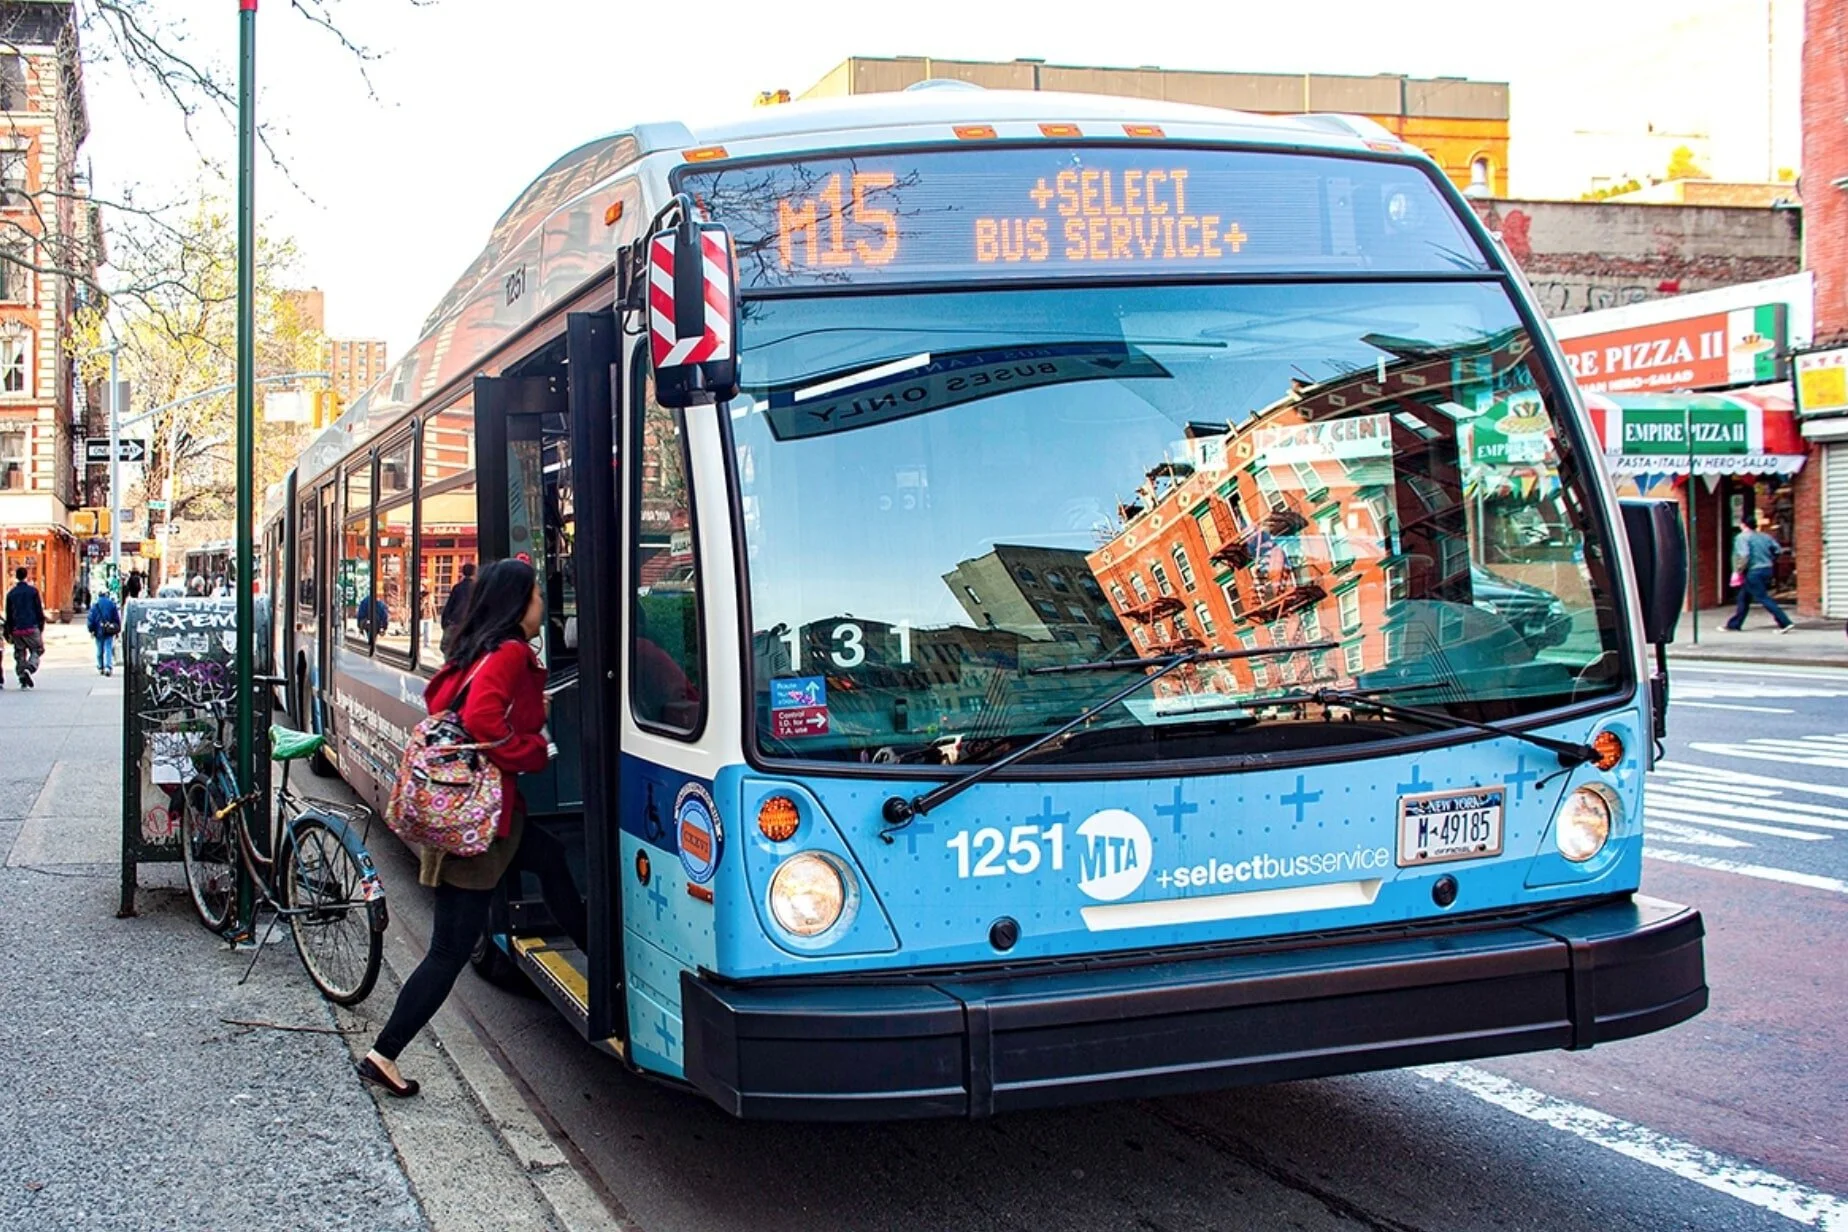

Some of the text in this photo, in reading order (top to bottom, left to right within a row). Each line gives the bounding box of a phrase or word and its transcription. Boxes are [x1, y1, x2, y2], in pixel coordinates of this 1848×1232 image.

[778, 172, 897, 267] M15
[976, 218, 1049, 261] BUS
[505, 264, 526, 306] 1251
[1604, 337, 1694, 374] PIZZA
[1699, 331, 1724, 360] II
[1625, 423, 1683, 442] EMPIRE
[1733, 424, 1744, 440] II
[1742, 457, 1778, 468] SALAD
[779, 711, 805, 720] Control
[1429, 796, 1480, 814] NEW YORK
[946, 822, 1064, 879] 1251
[1079, 833, 1139, 884] MTA
